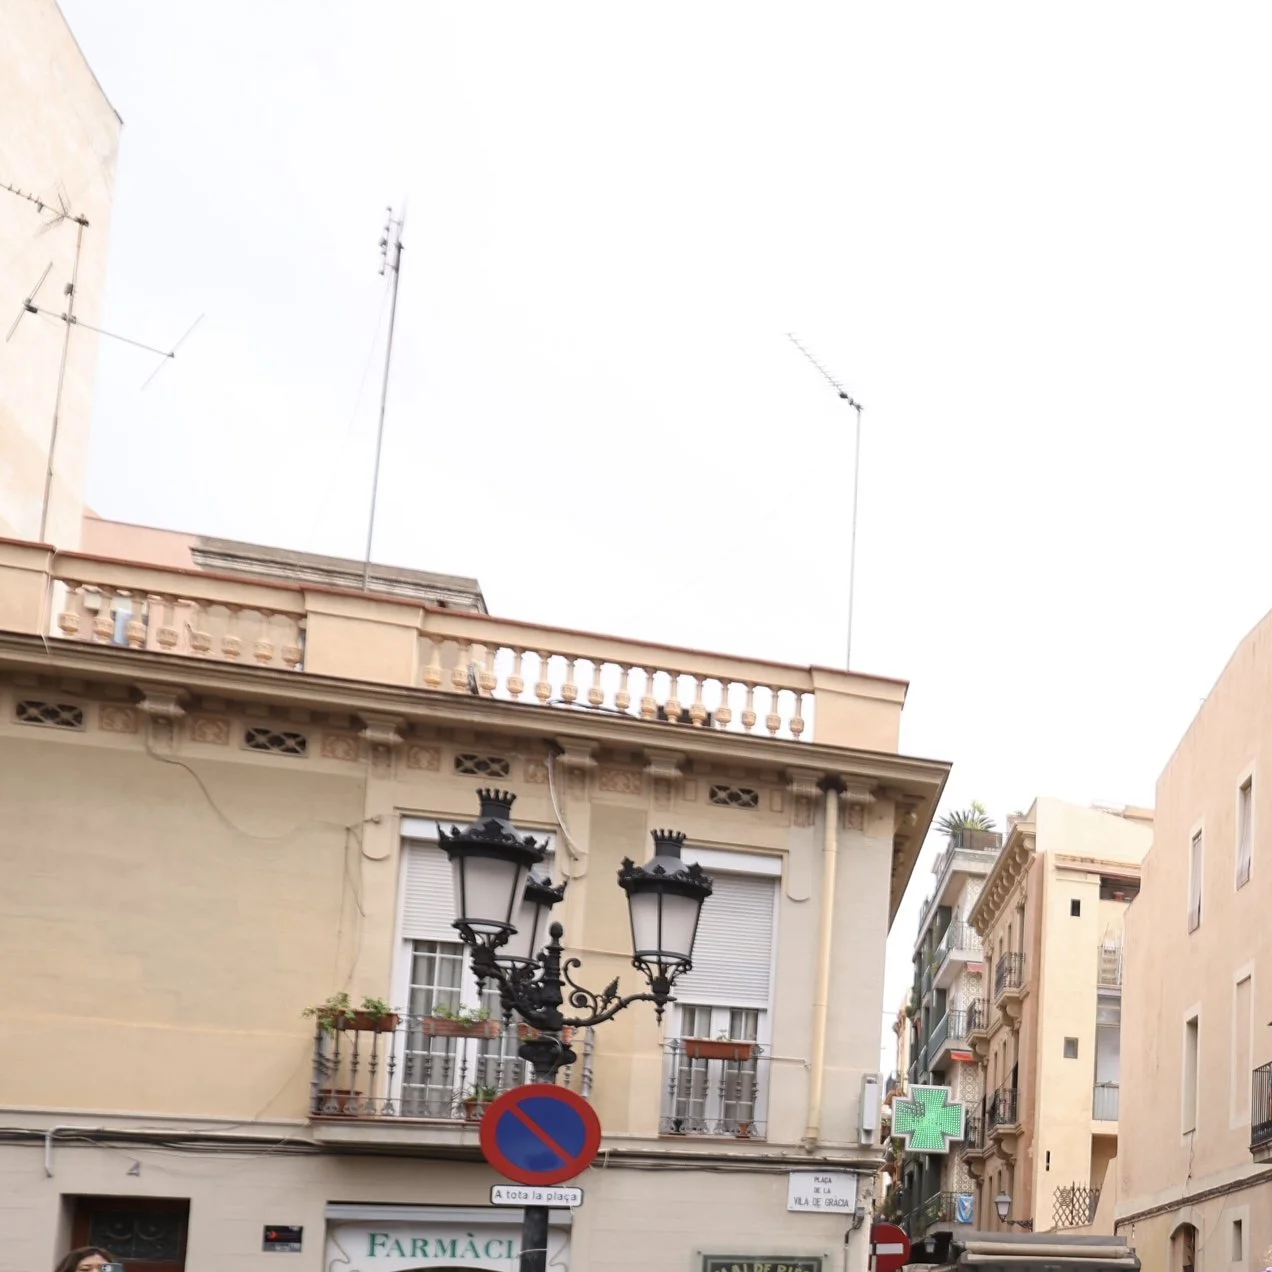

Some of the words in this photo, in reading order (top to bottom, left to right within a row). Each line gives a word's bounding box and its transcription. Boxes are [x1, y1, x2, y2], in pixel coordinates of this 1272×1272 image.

[814, 1176, 832, 1184] PLAÇA
[495, 1190, 502, 1198] A
[507, 1191, 528, 1199] tota
[533, 1191, 542, 1200] la
[547, 1192, 577, 1203] plaça
[794, 1197, 809, 1206] VILA
[813, 1198, 821, 1206] DE
[366, 1231, 521, 1259] FARMÀCI
